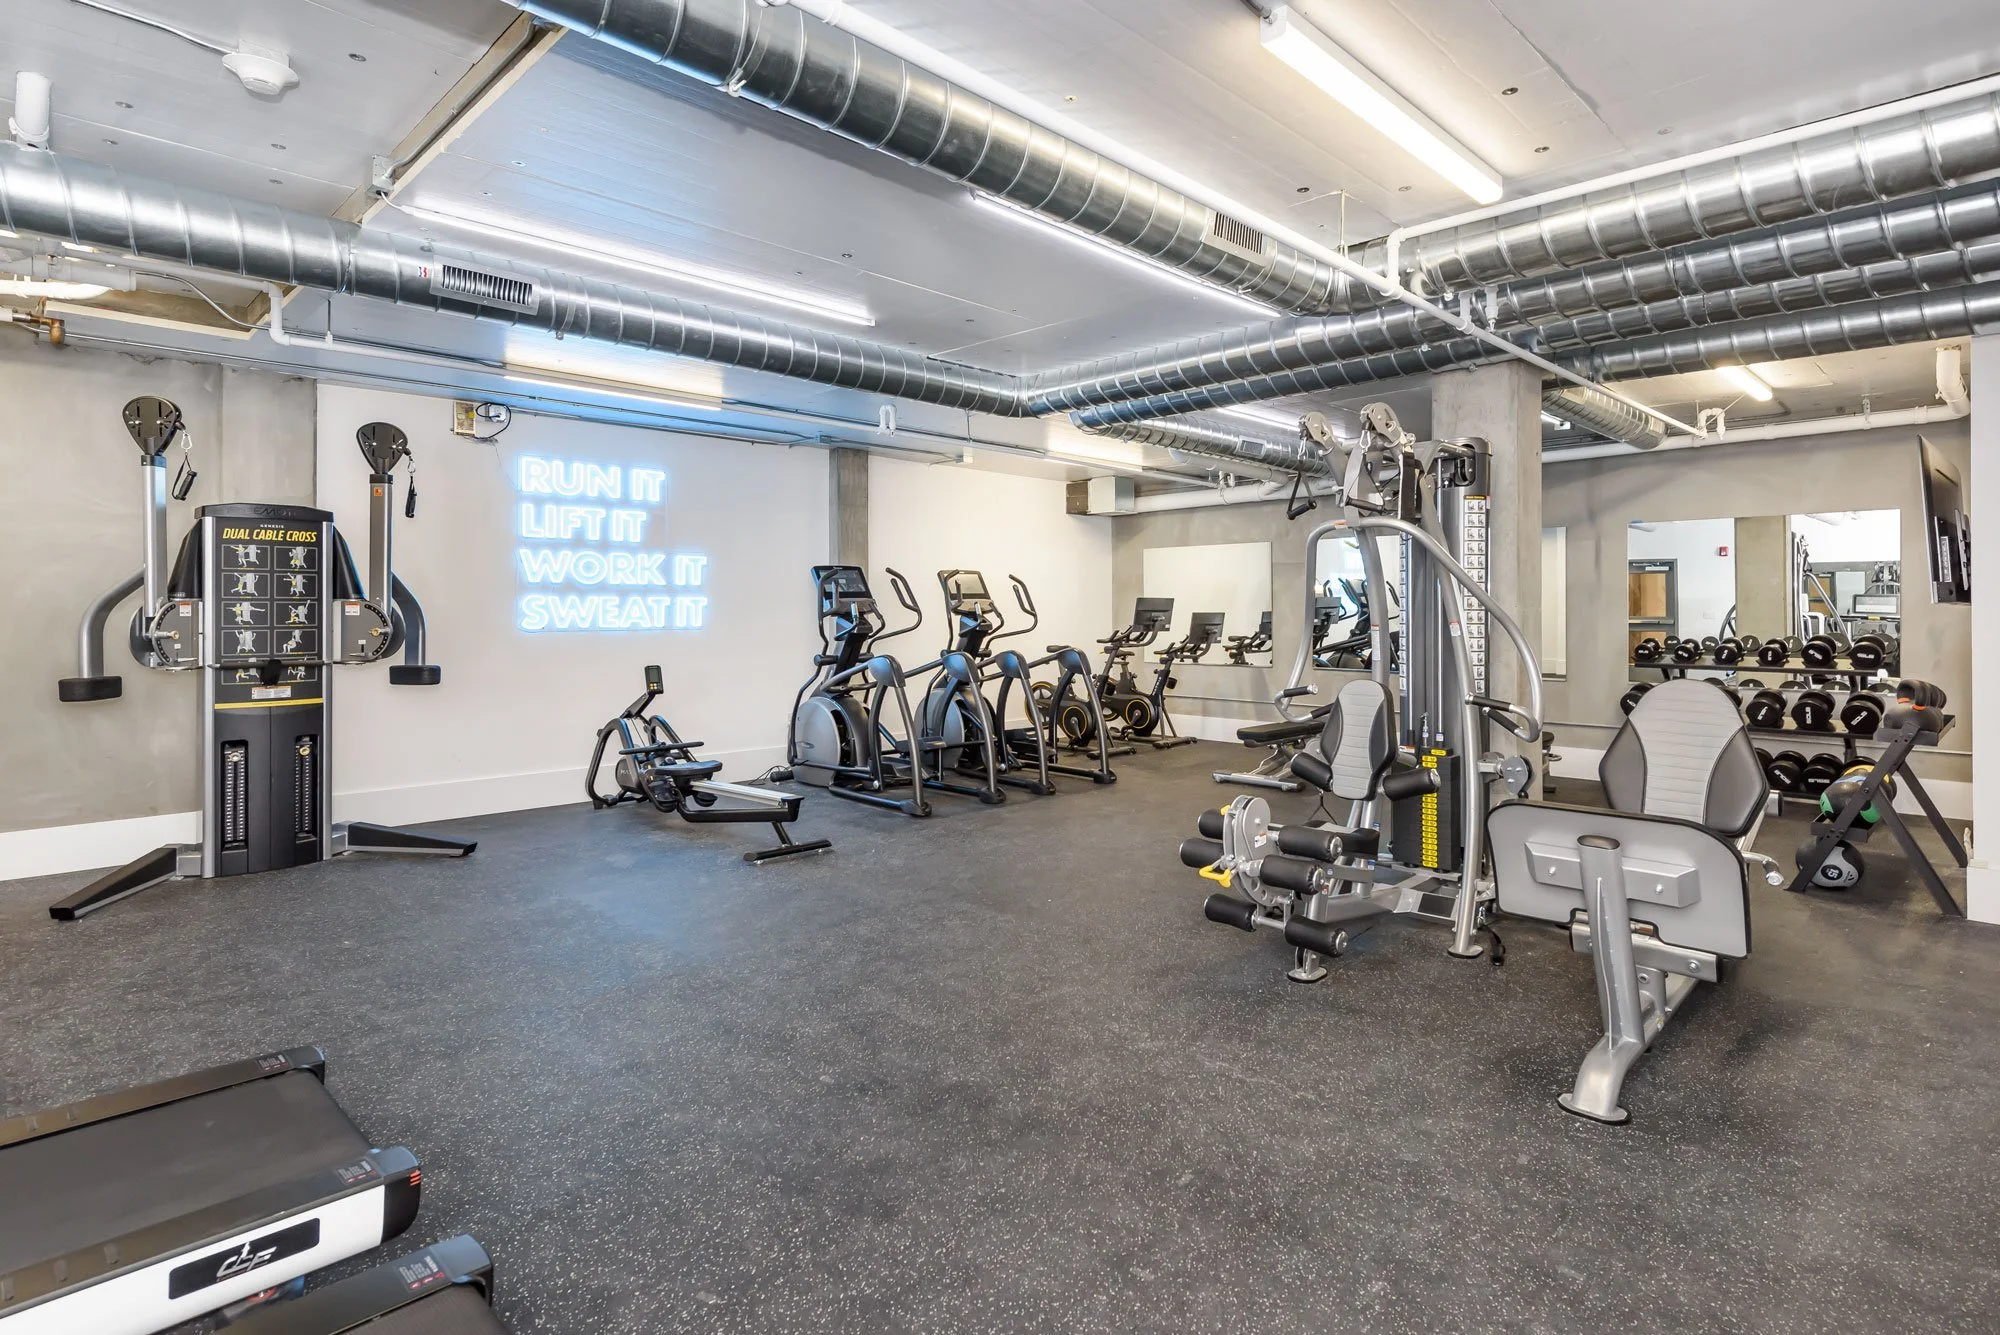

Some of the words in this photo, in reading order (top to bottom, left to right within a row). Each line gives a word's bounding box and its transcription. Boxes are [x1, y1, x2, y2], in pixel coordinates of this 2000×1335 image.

[520, 456, 621, 499] RUN
[631, 468, 666, 501] IT
[222, 527, 250, 540] DUAL
[252, 529, 285, 541] CABLE
[286, 530, 317, 542] CROSS
[520, 503, 607, 541] LIFT
[611, 509, 647, 543] IT
[519, 549, 667, 586] WORK
[674, 555, 708, 586] IT
[520, 594, 671, 630] SWEAT
[675, 596, 708, 628] IT
